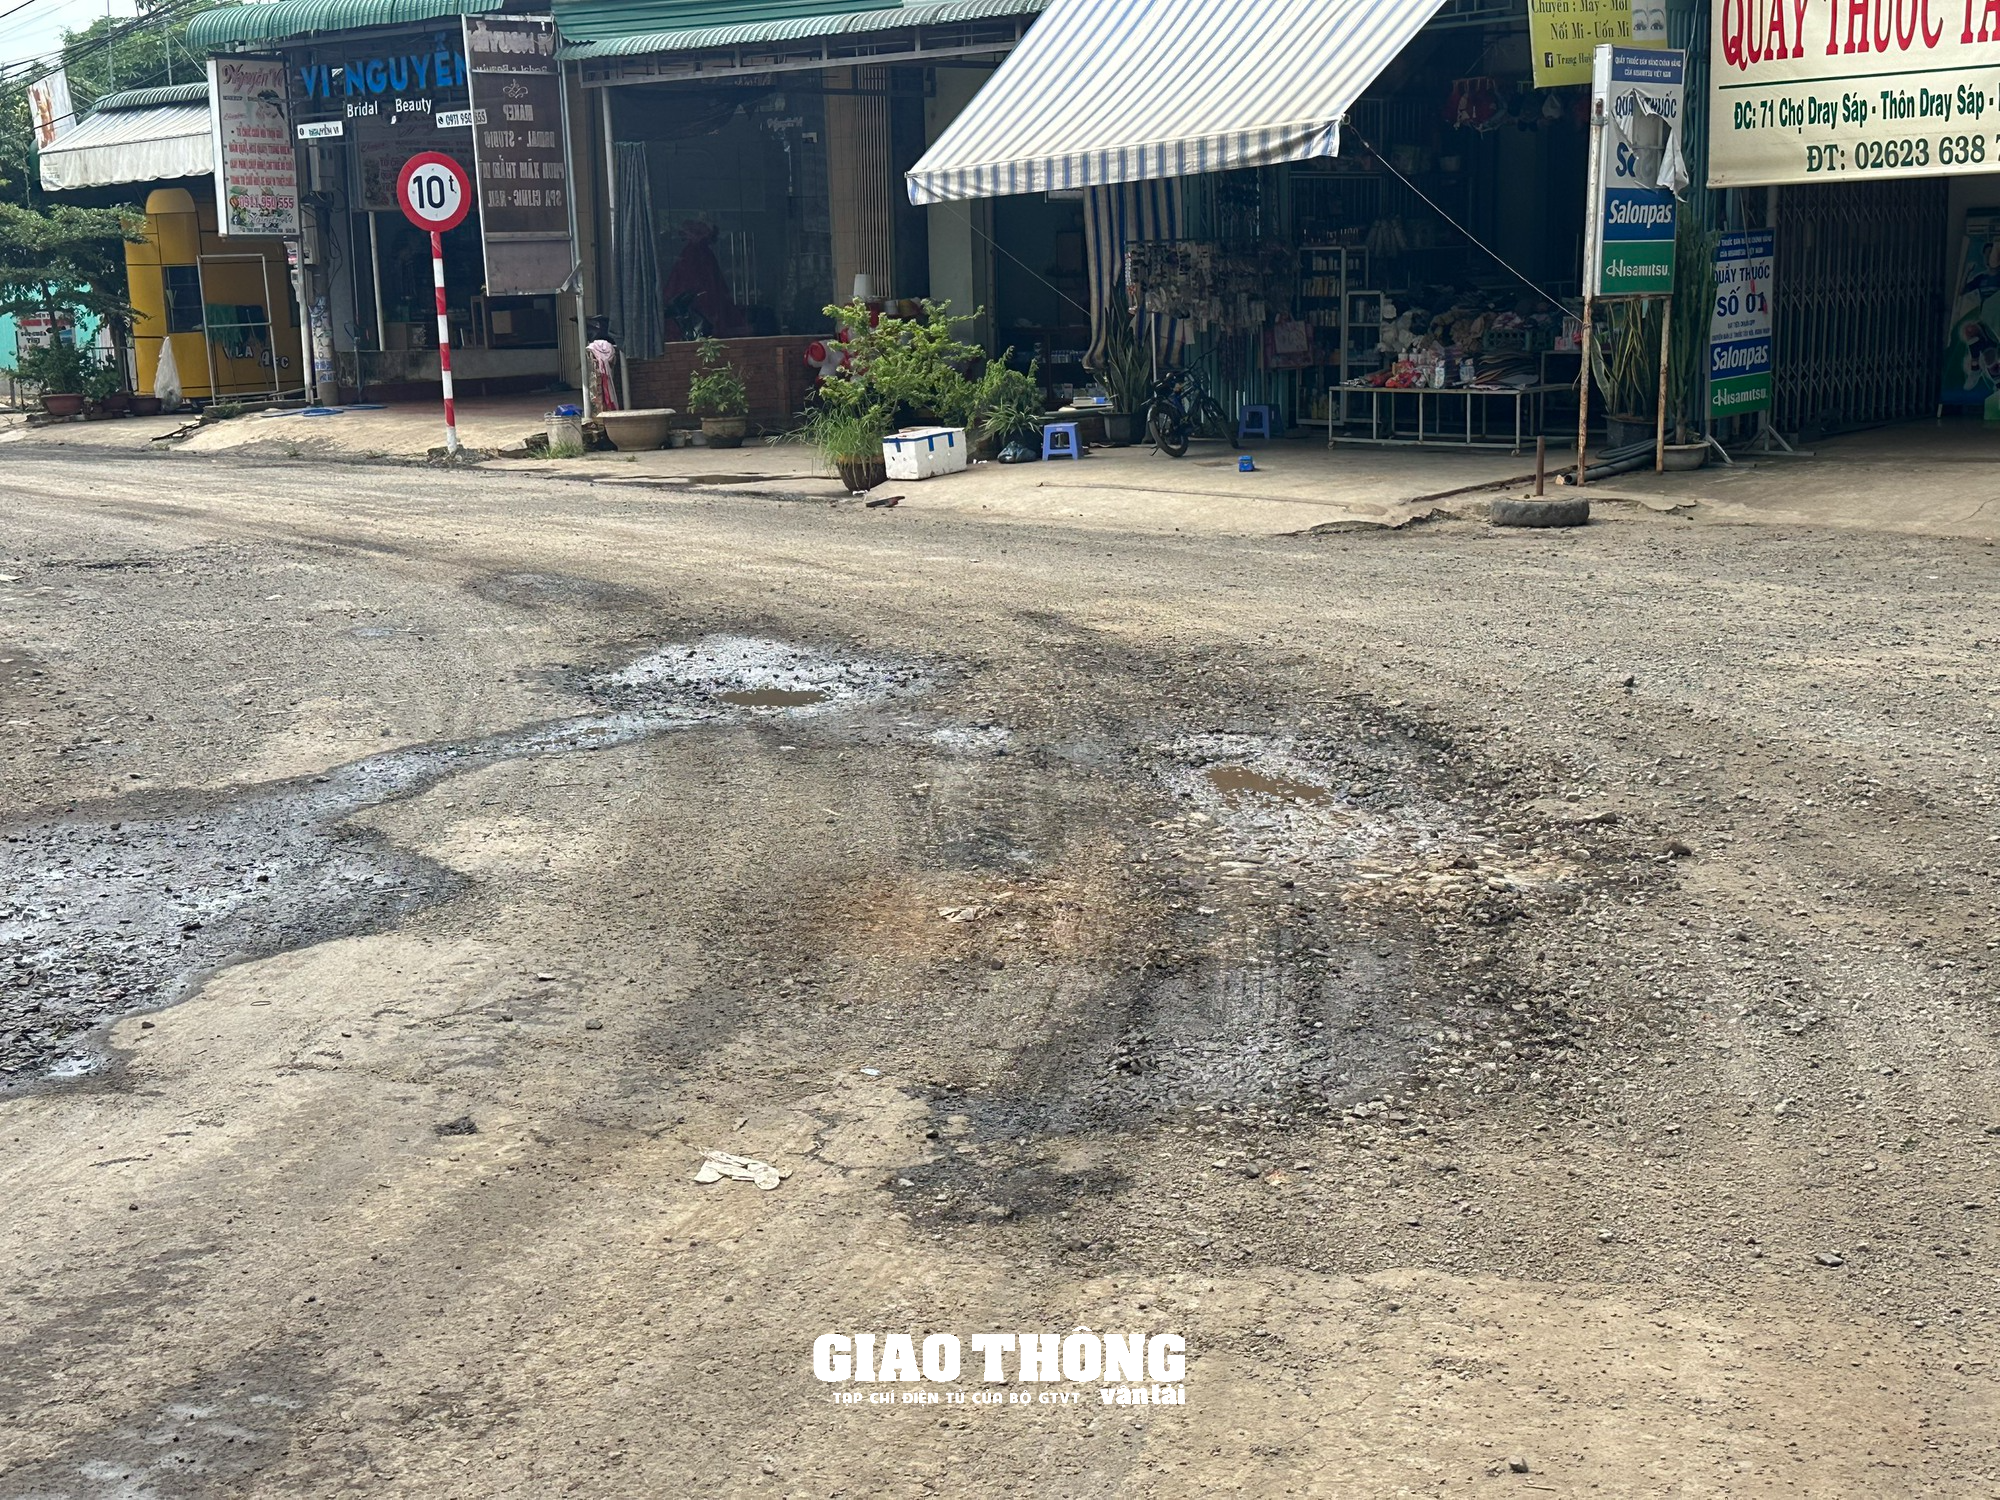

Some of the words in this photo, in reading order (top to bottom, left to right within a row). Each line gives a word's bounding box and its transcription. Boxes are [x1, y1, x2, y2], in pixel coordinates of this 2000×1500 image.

[1550, 21, 1568, 40] Nối
[1572, 22, 1584, 39] Mi
[1594, 20, 1614, 38] Uốn
[1618, 20, 1630, 38] Mi
[301, 64, 330, 97] VI
[347, 100, 378, 118] Bridal
[396, 98, 432, 114] Beauty
[1734, 100, 1756, 130] ĐC:
[1760, 100, 1774, 128] 71
[1780, 98, 1804, 134] Chợ
[1808, 96, 1838, 130] Dray
[1842, 92, 1867, 128] Sáp
[1880, 90, 1915, 120] Thôn
[1920, 88, 1952, 122] Dray
[1957, 83, 1984, 120] Sáp
[1806, 144, 1846, 172] ĐT:
[1854, 138, 1930, 170] 02623
[1939, 134, 1985, 164] 638
[413, 175, 445, 209] 10
[448, 175, 457, 194] t
[1608, 200, 1672, 228] Salonpas
[1606, 259, 1668, 277] Hisamitsu
[1740, 260, 1770, 281] THUỐC
[1717, 286, 1740, 317] SỐ
[1746, 292, 1766, 313] 01
[1712, 345, 1768, 371] Salonpas
[1713, 388, 1766, 406] Hisamitsu
